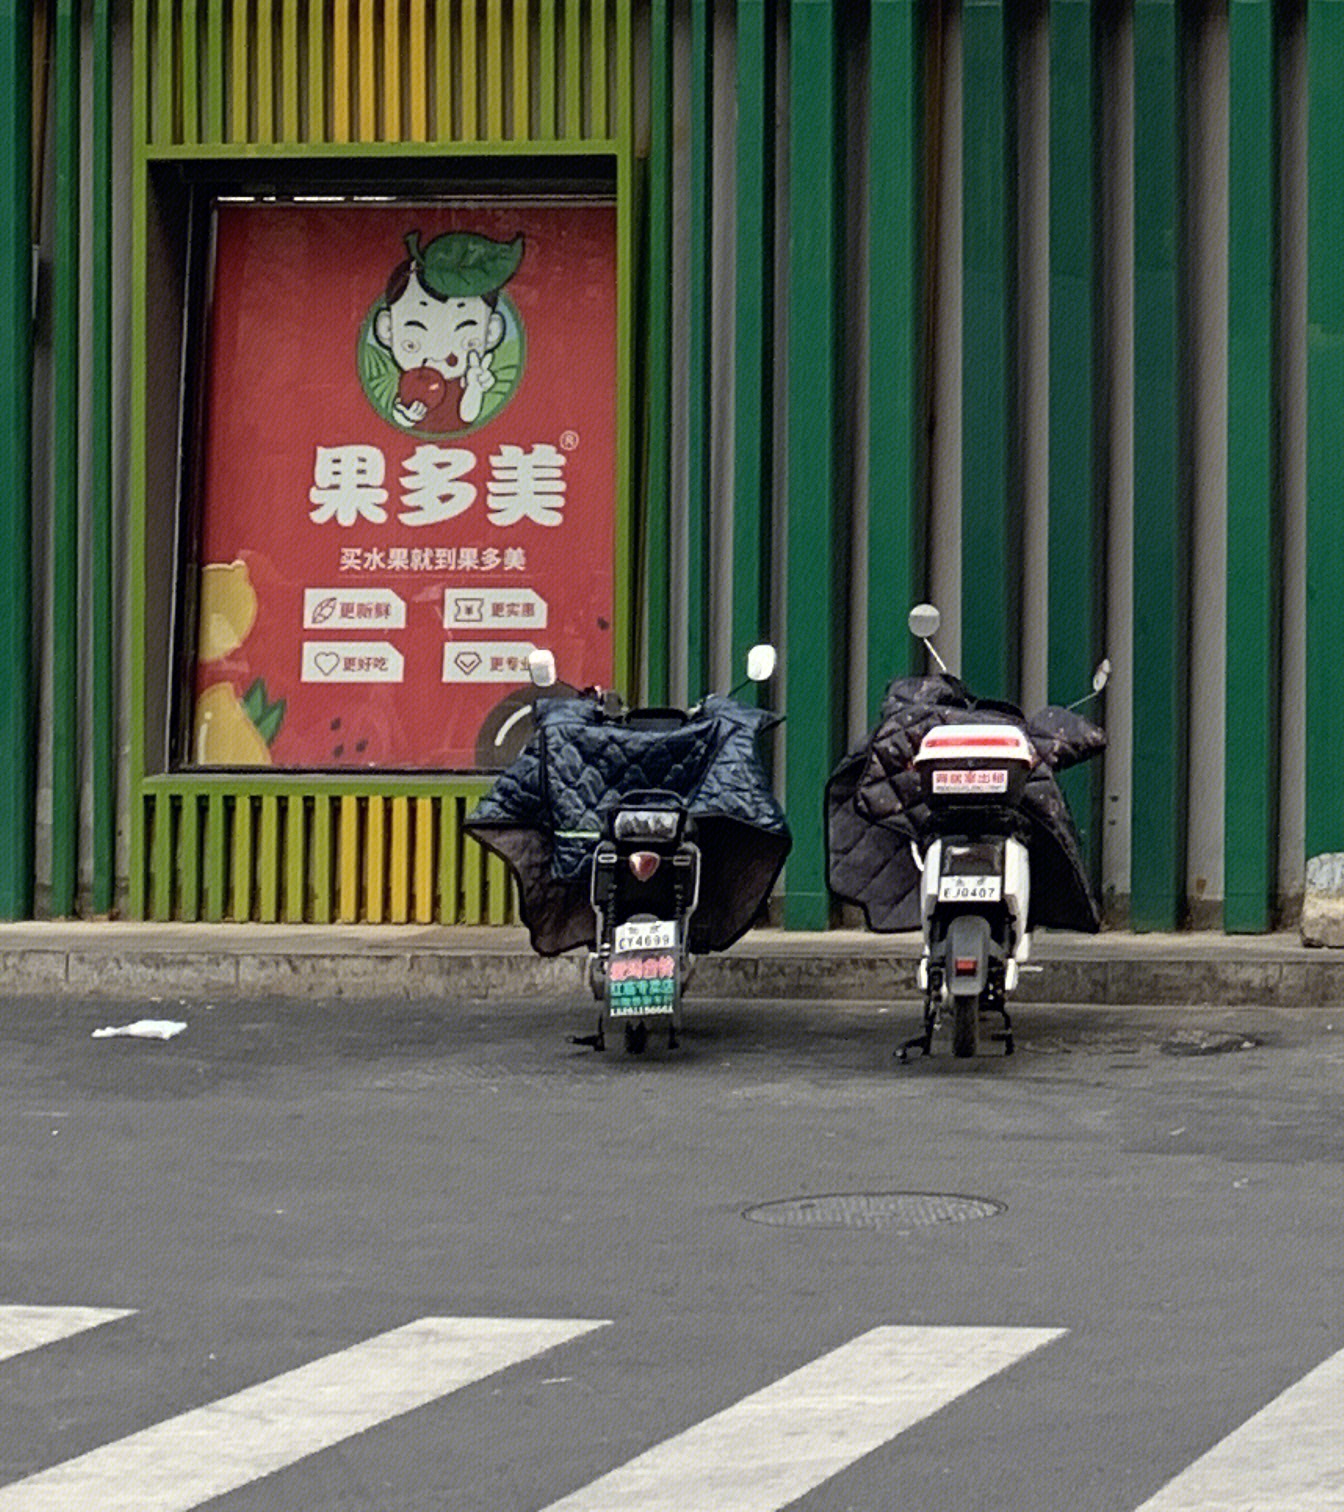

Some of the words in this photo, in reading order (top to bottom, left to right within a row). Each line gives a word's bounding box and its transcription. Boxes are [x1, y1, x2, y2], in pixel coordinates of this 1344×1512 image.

[309, 444, 567, 528] 果多美
[339, 547, 526, 571] 买水果就到果多美
[339, 602, 391, 620] 更新鲜
[491, 602, 535, 619] 更实惠
[343, 656, 389, 673] 更好吃
